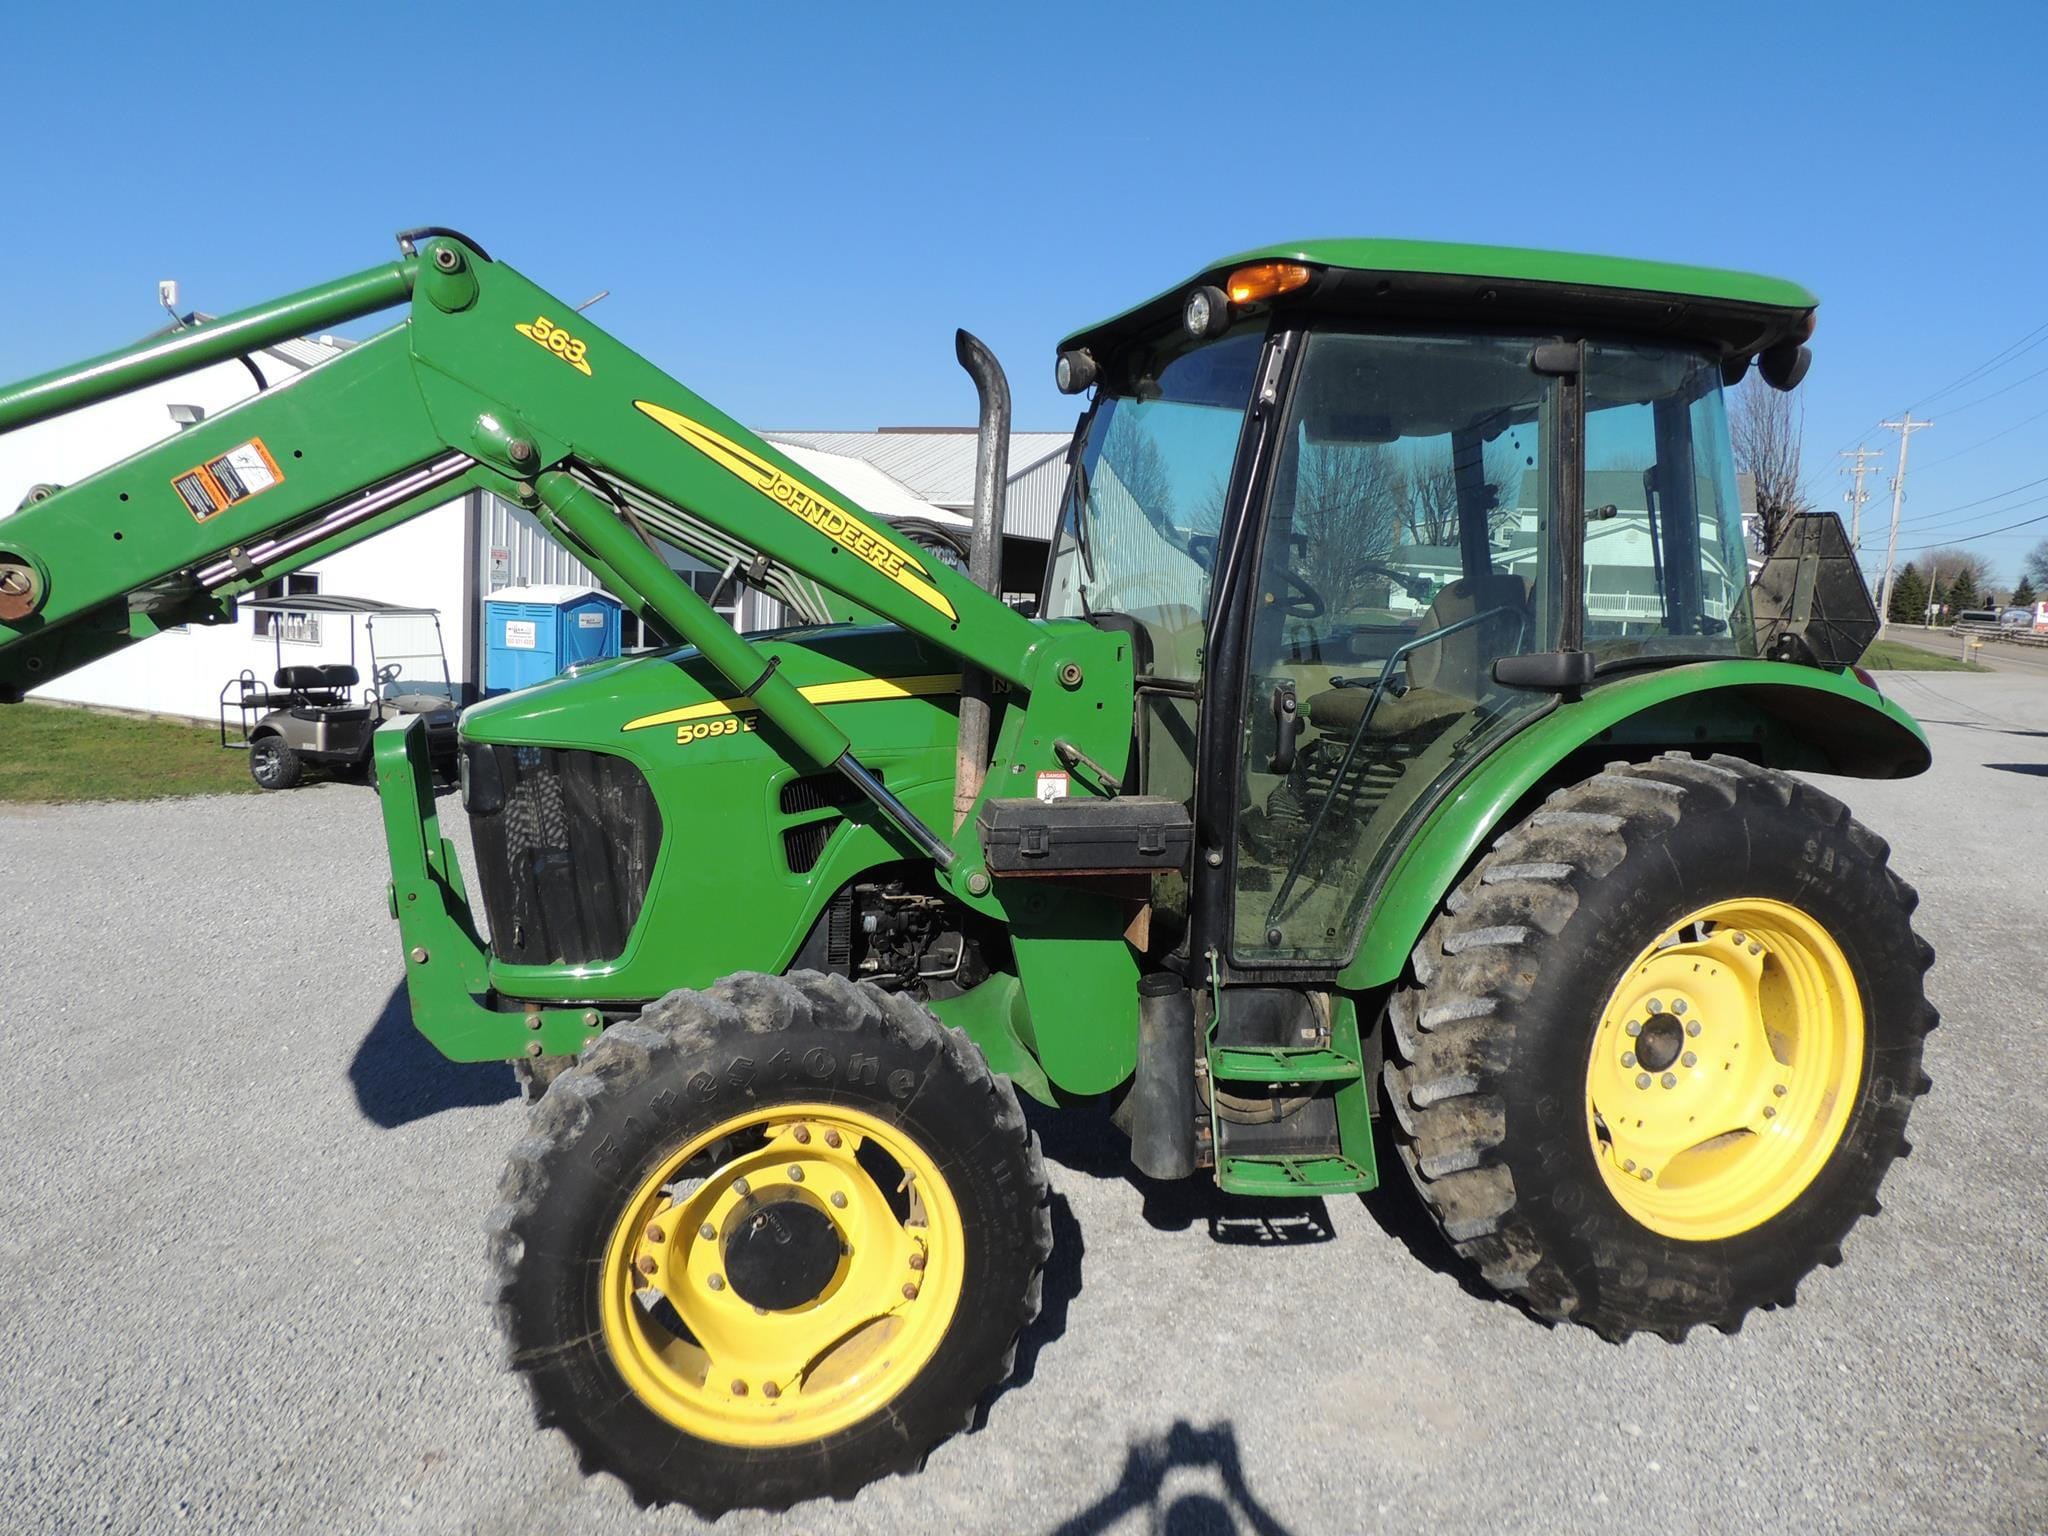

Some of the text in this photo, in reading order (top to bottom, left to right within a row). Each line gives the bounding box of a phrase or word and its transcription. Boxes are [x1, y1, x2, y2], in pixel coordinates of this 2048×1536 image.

[530, 315, 587, 364] 563
[757, 471, 906, 578] JOHN DEERE
[676, 716, 758, 746] 5093 E
[591, 1047, 916, 1176] Firestone
